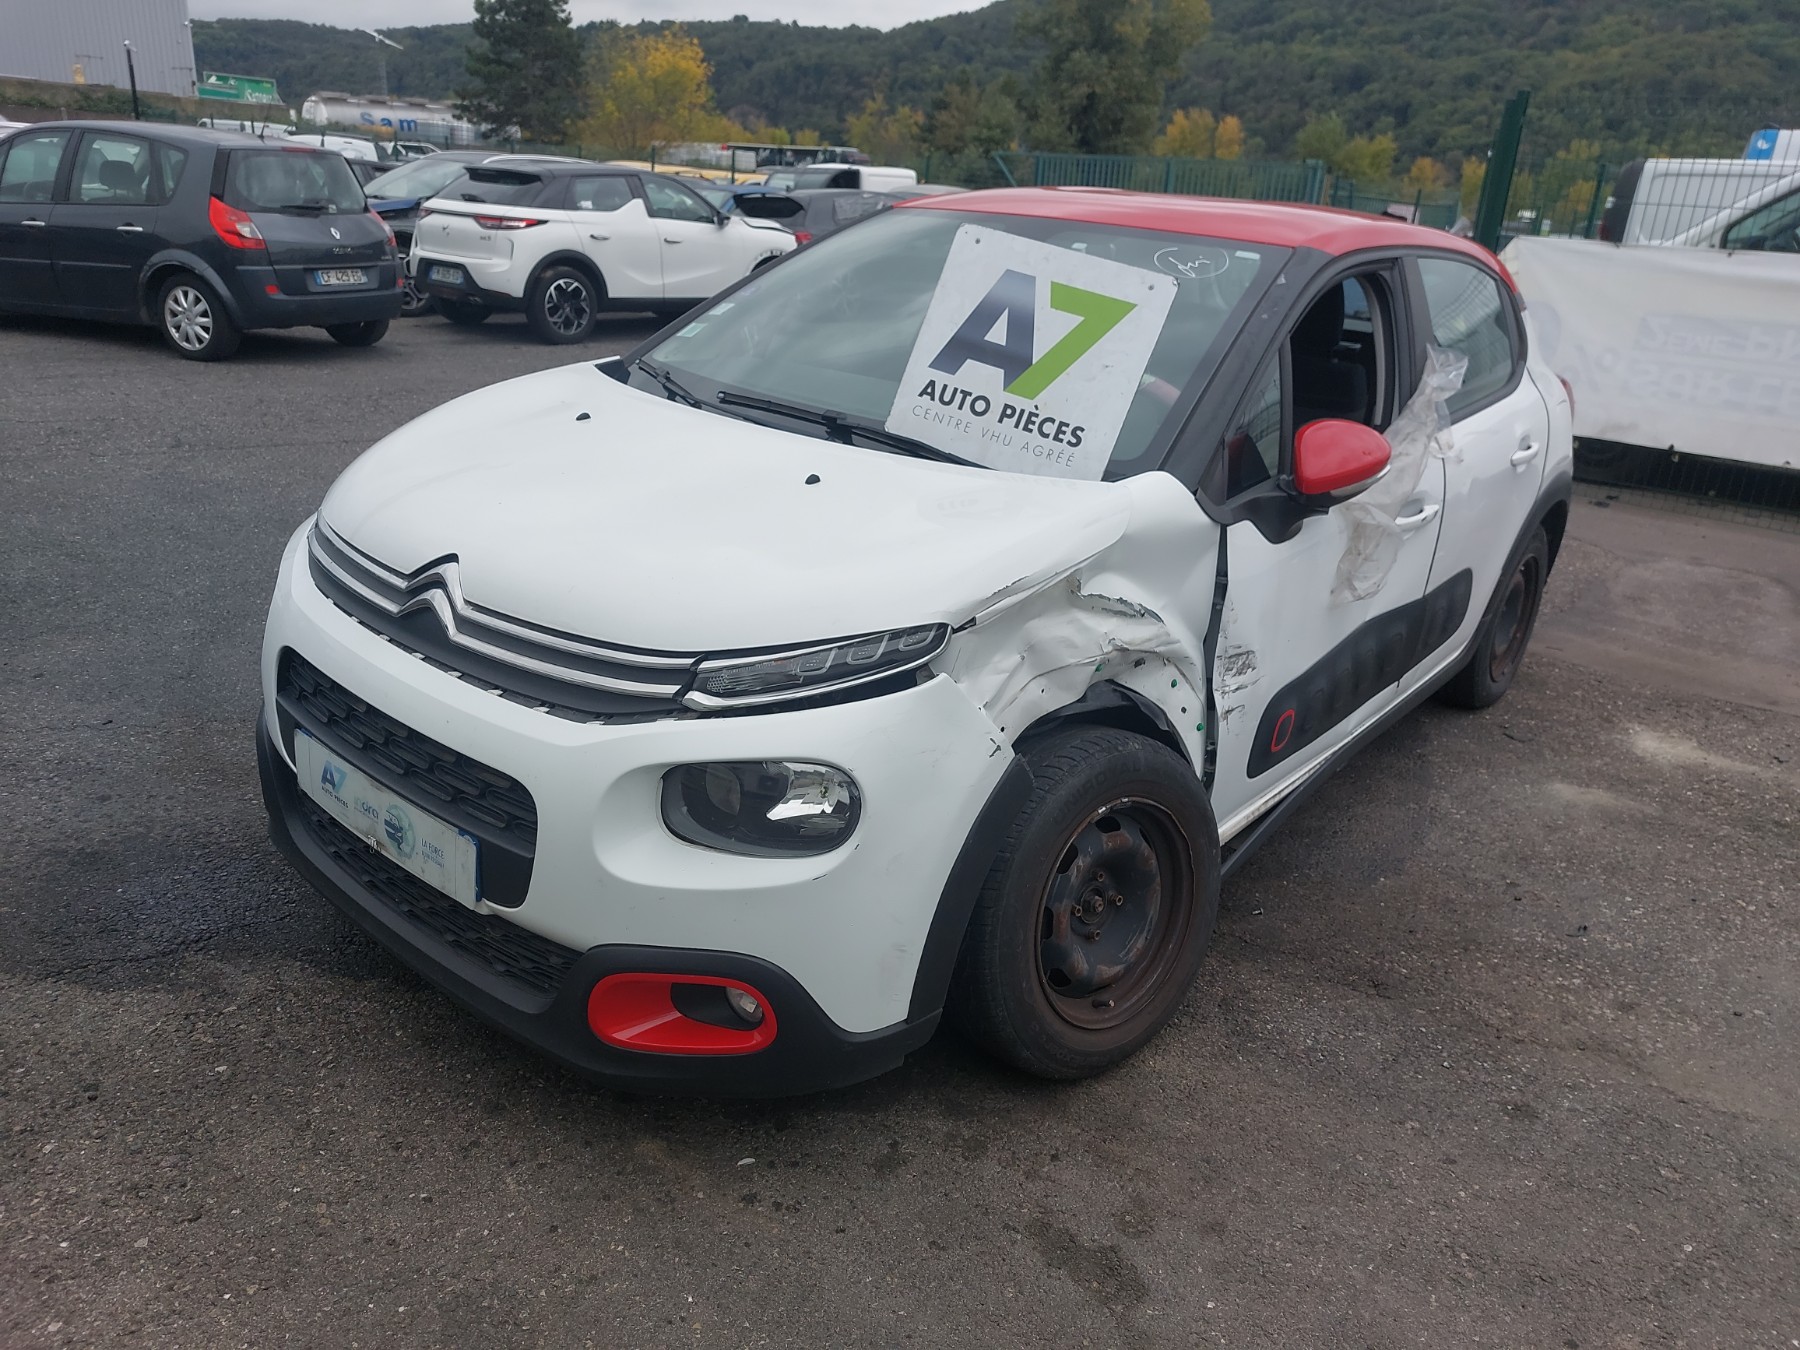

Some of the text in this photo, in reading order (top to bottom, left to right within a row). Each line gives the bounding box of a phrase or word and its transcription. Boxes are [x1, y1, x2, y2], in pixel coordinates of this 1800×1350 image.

[928, 269, 1138, 400] A7
[912, 404, 1076, 468] CENTRE VHU AGRÉÉ
[918, 379, 1086, 449] AUTO PIÈCES
